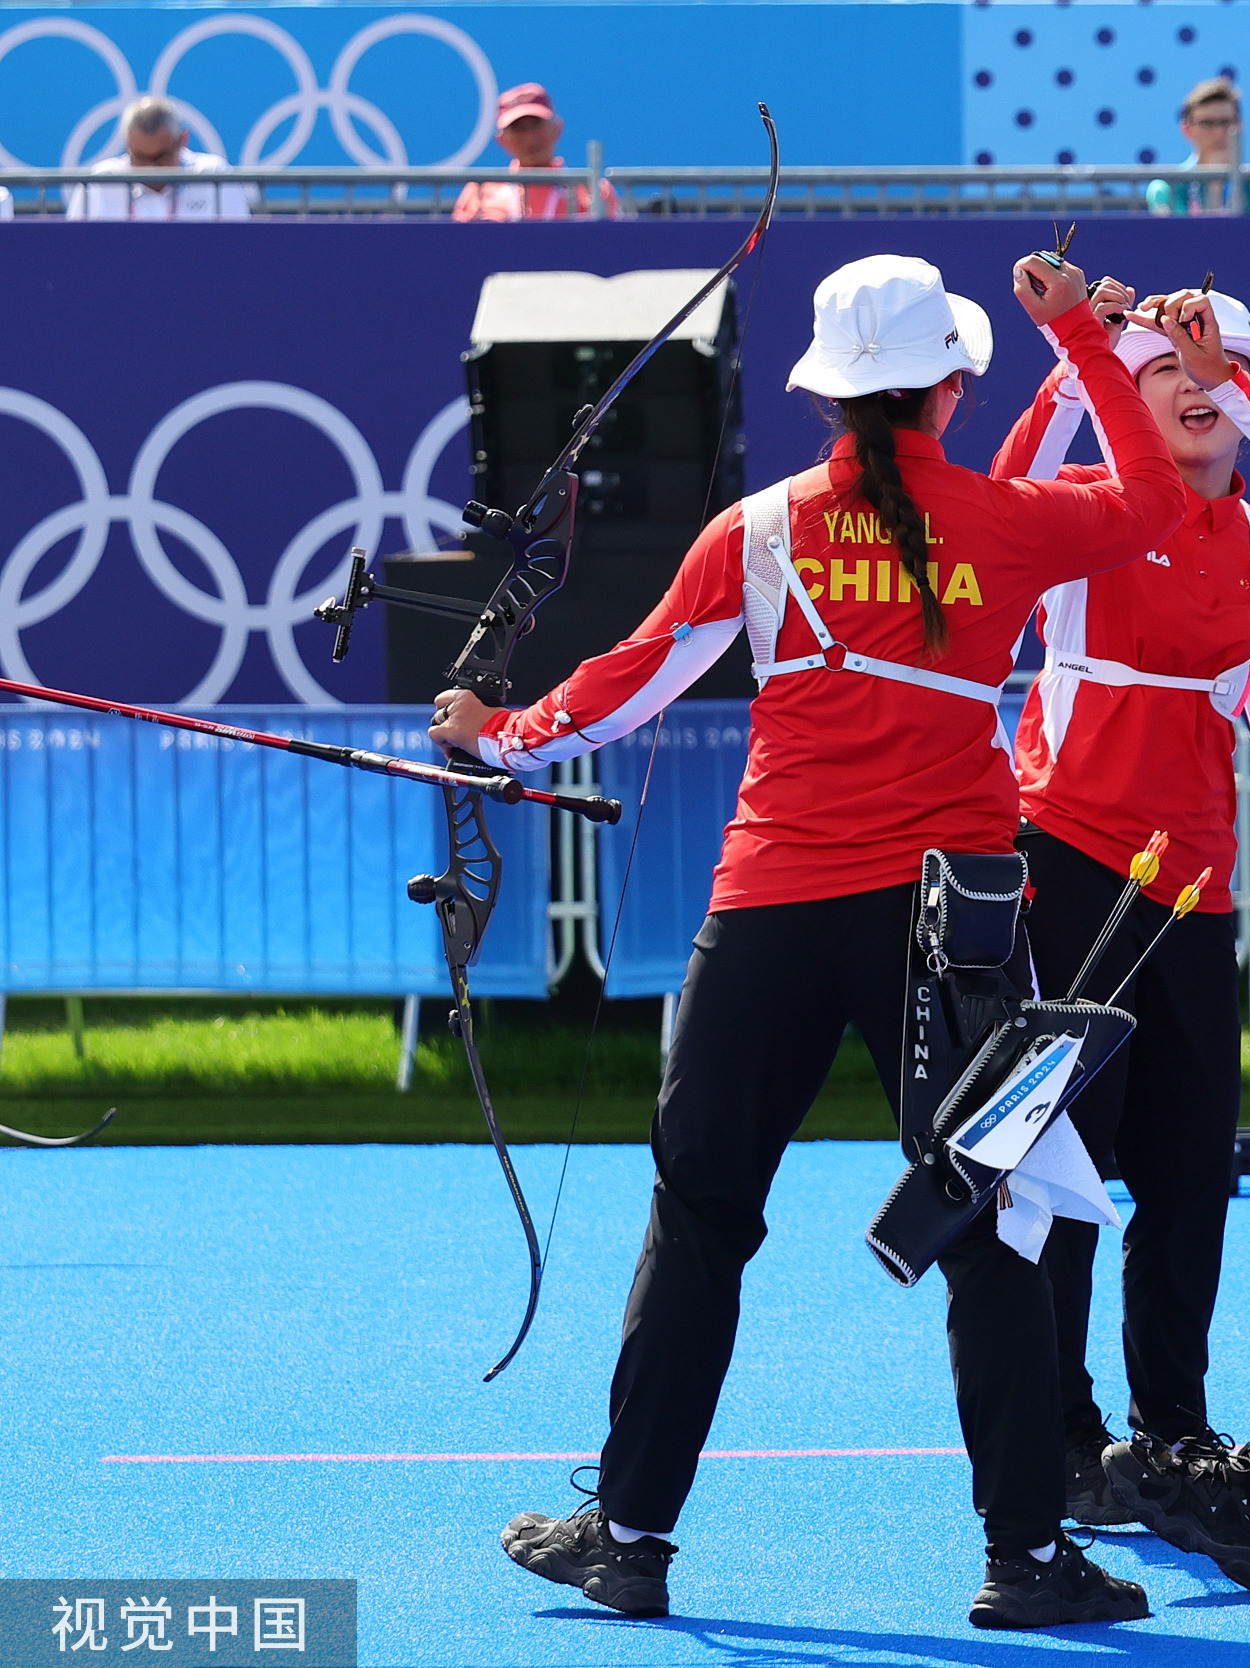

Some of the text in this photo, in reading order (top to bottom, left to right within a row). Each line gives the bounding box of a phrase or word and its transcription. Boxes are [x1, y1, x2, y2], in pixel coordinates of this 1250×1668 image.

[823, 511, 892, 544] YANG
[1146, 550, 1171, 567] ILA
[790, 557, 983, 606] CHINA
[1058, 662, 1093, 674] ANGEL
[914, 986, 931, 1079] CHINA
[998, 1060, 1056, 1113] PARIS 2024
